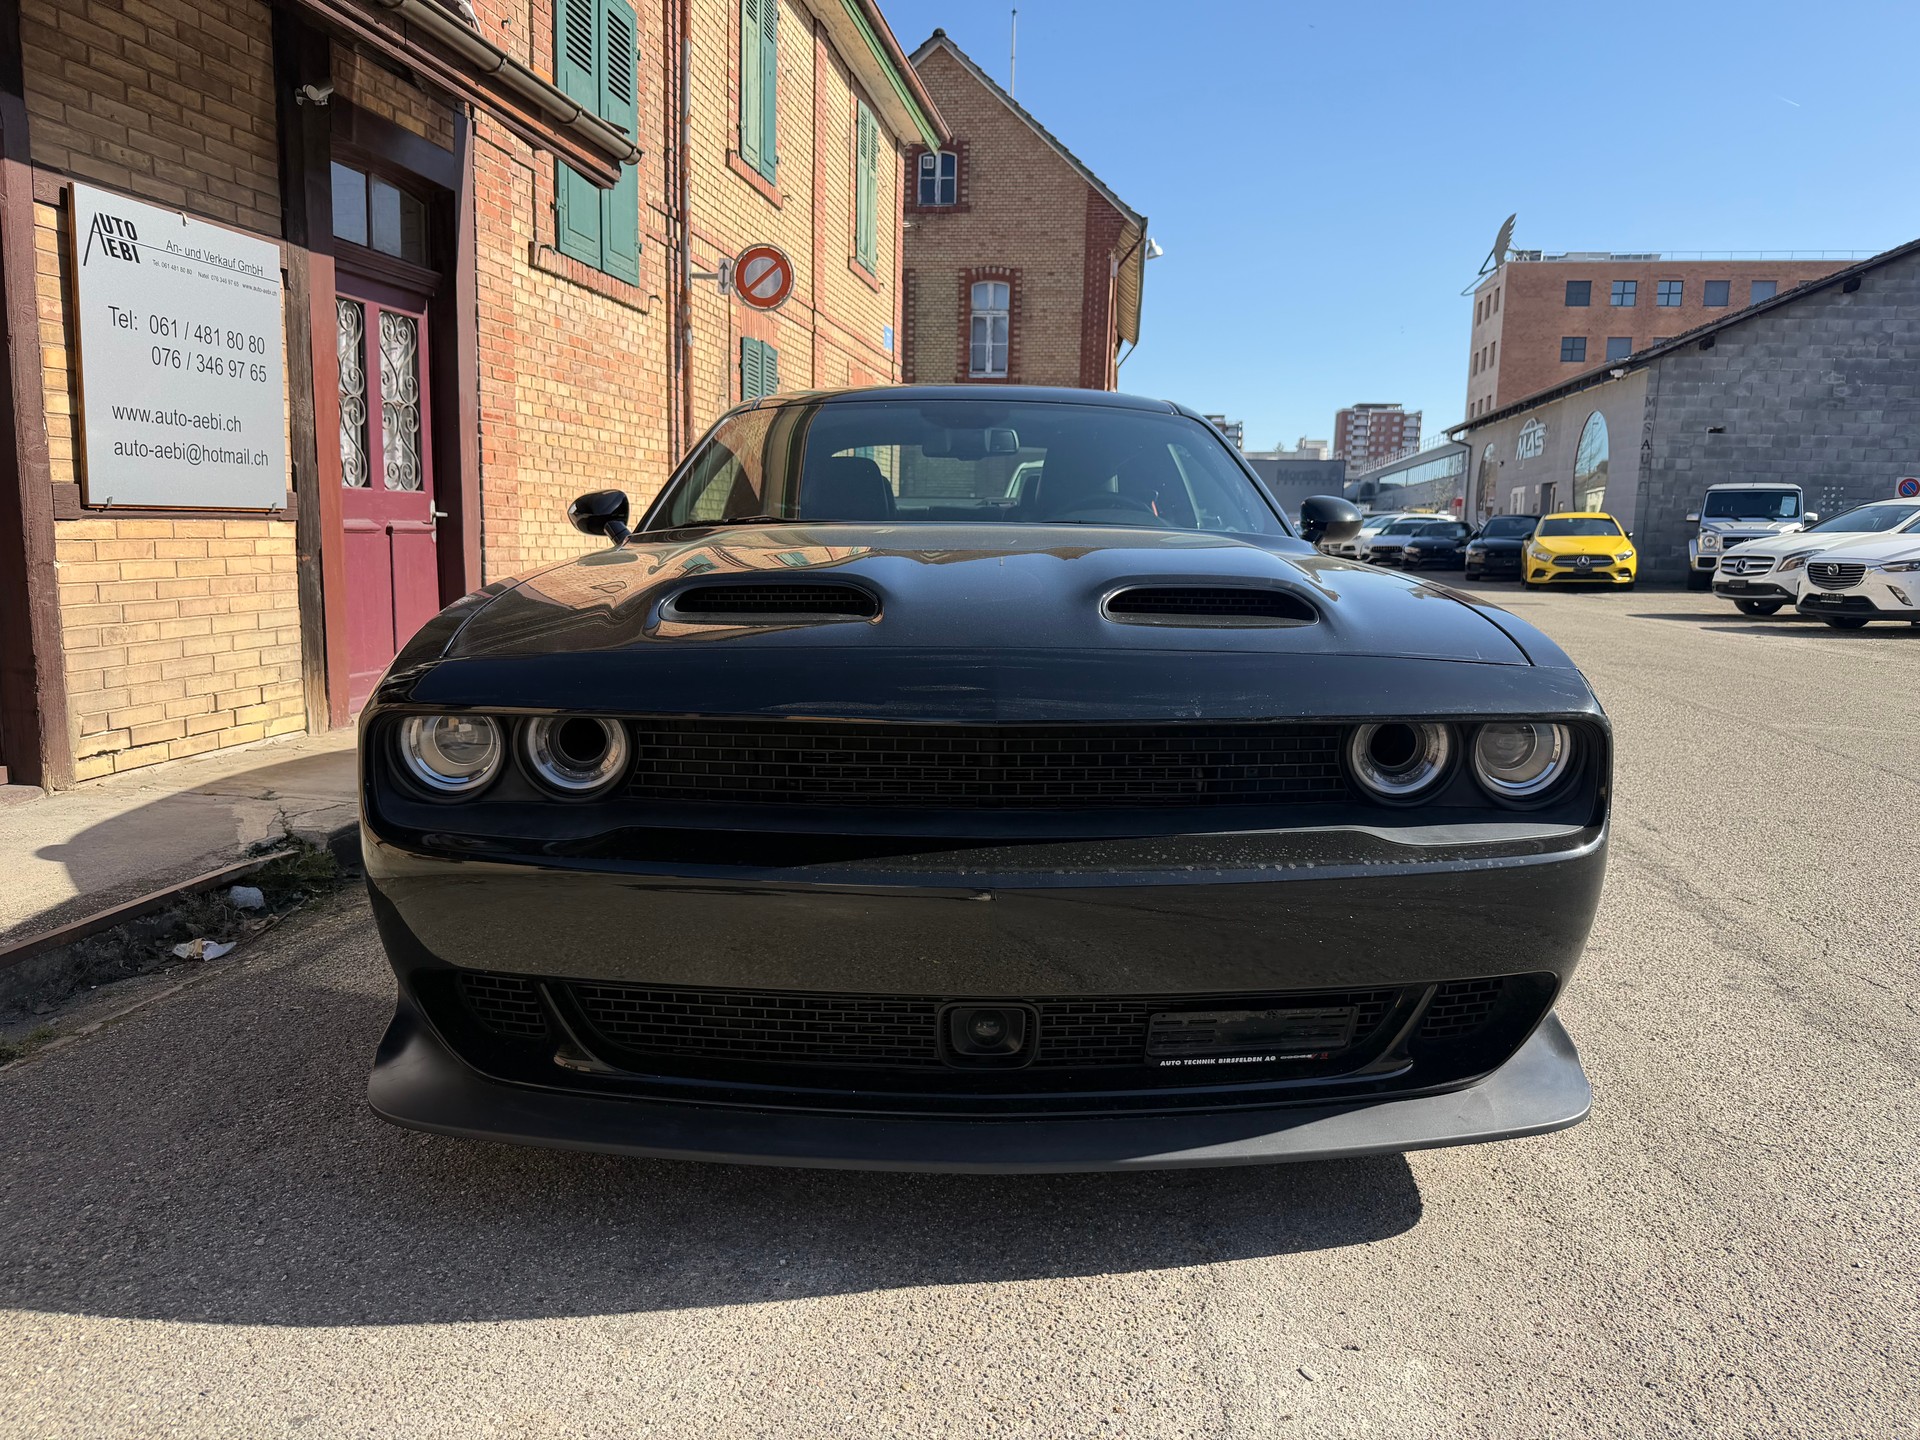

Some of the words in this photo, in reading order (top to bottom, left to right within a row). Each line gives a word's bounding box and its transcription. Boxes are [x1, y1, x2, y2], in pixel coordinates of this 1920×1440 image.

[152, 259, 160, 268] Tel.
[161, 262, 170, 270] 061
[170, 264, 180, 272] 481
[166, 240, 182, 254] An-
[185, 248, 201, 260] und
[204, 250, 236, 269] Verkauf
[238, 260, 264, 276] GmbH
[107, 305, 138, 331] Tel:
[149, 314, 178, 338] 061
[184, 321, 190, 340] /
[193, 324, 220, 346] 481
[226, 330, 244, 350] 80
[248, 335, 265, 354] 80
[151, 346, 181, 369] 076
[186, 352, 191, 370] /
[196, 353, 224, 376] 346
[228, 359, 245, 379] 97
[250, 363, 267, 382] 65
[111, 405, 242, 433] www.auto-aebi.ch
[113, 439, 269, 466] auto-aebi@hotmail.ch
[1515, 424, 1546, 460] MAS
[1160, 1059, 1182, 1067] AUTO
[1218, 1056, 1263, 1064] BIRSFELDEN
